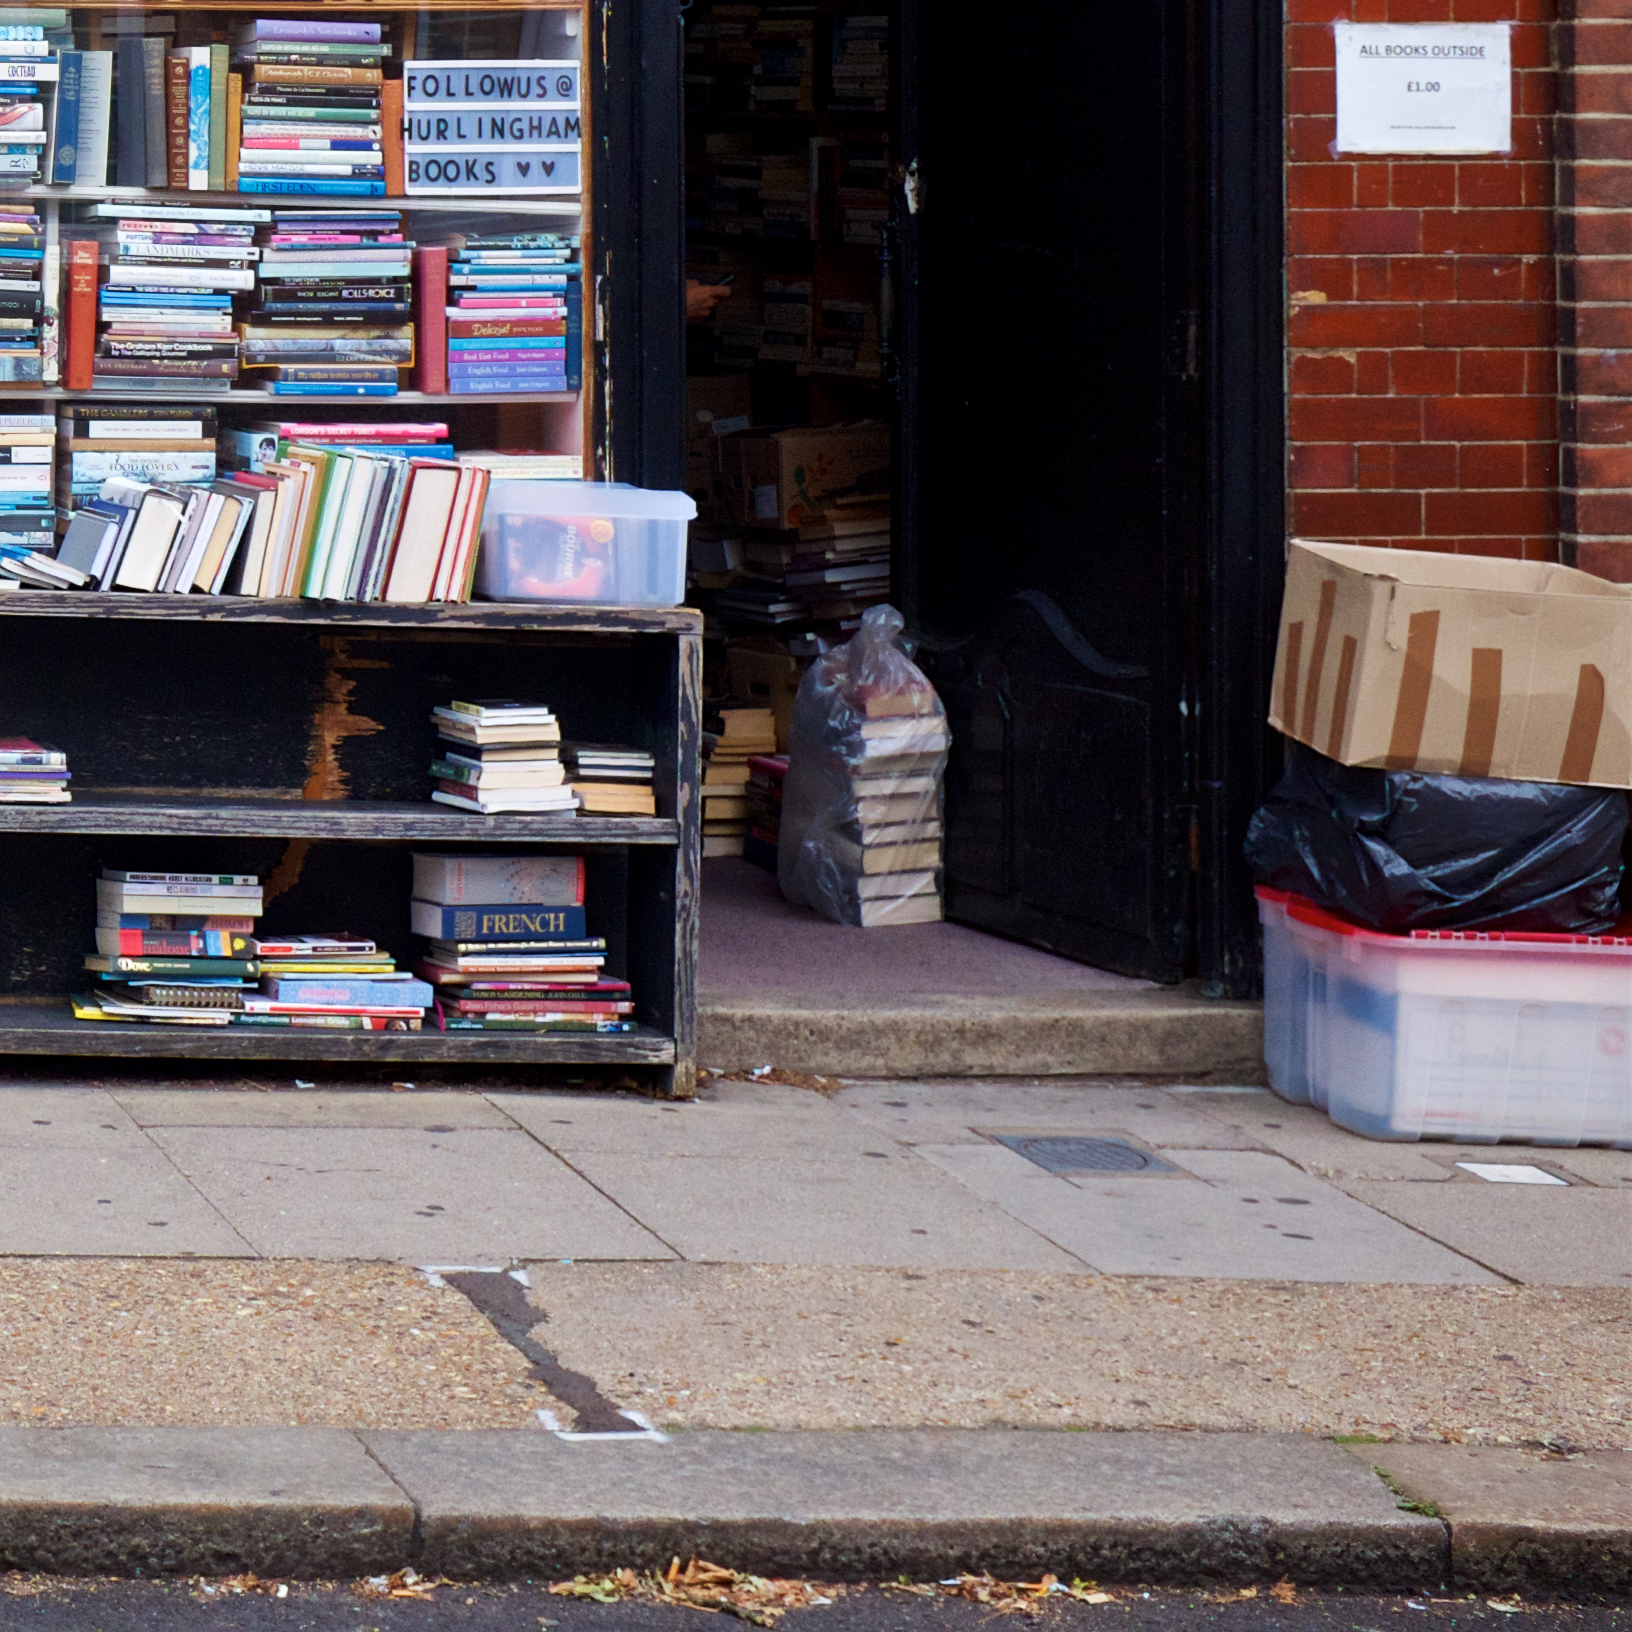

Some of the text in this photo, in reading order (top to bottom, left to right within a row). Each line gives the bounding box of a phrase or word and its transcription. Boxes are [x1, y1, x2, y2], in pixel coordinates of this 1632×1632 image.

[1360, 45, 1485, 56] ALL BOOKS OUTSIDE
[1407, 82, 1440, 92] £1.00
[401, 116, 581, 140] HURLINGHAM
[408, 159, 496, 184] BOOKS
[255, 182, 316, 194] FIRST EDEN
[482, 912, 566, 934] FRENCH
